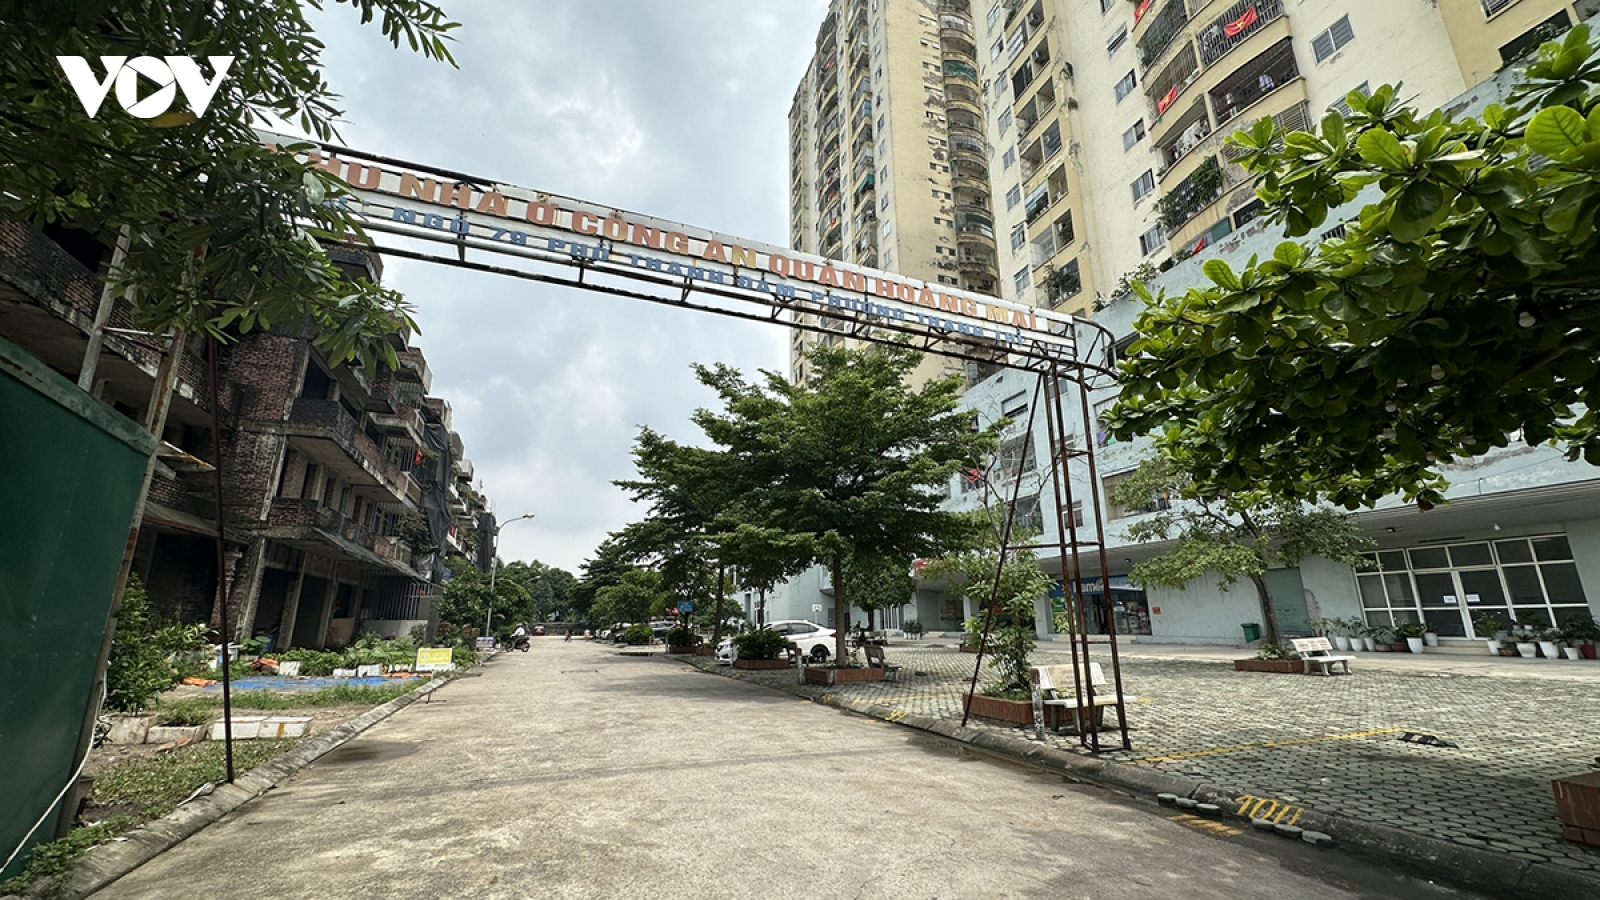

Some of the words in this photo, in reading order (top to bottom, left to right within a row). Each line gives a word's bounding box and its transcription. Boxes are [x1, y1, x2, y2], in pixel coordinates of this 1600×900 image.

[489, 225, 527, 246] 79
[630, 252, 725, 285] THANH
[915, 312, 984, 338] THANH
[571, 208, 689, 256] CÔNG
[702, 239, 757, 269] AN
